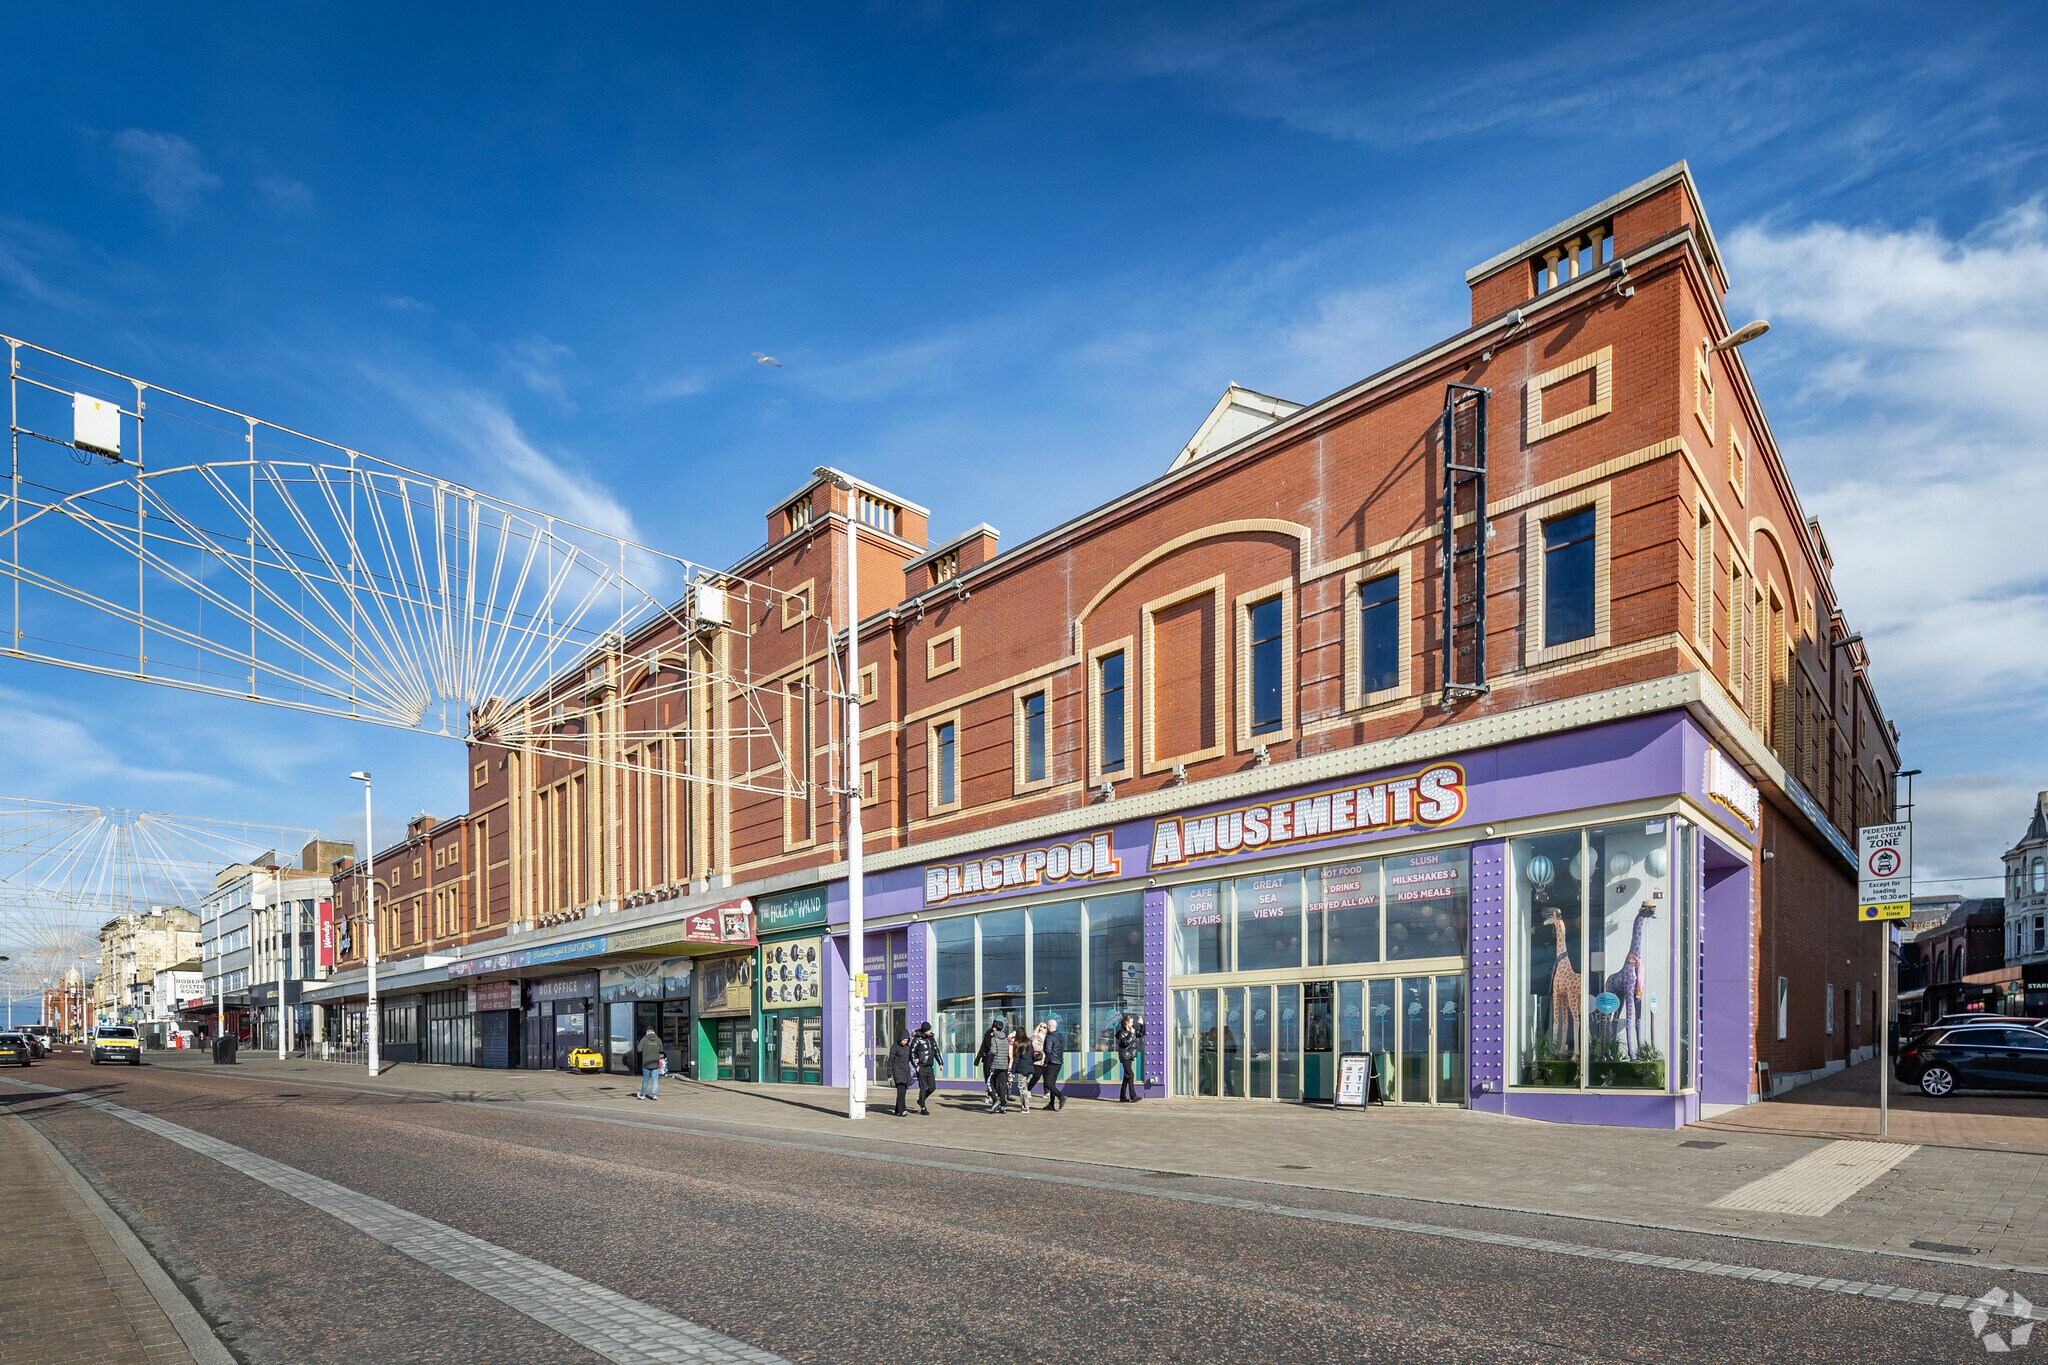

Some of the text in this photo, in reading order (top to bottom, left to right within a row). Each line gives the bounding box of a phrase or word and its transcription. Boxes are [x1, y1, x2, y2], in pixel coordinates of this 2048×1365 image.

[1152, 766, 1463, 866] AMUSEMENTS
[1862, 825, 1907, 835] PEDESTRIAN
[1880, 831, 1903, 839] CYCLE
[1869, 838, 1900, 849] ZONE
[1409, 855, 1439, 867] SLUSH
[925, 832, 1118, 904] BLACKPOOL
[1320, 866, 1362, 879] HOT FOOD
[1392, 869, 1459, 886] MILKSHAKES &
[1253, 878, 1284, 891] GREAT
[1323, 881, 1360, 894] & DRINKS
[1868, 881, 1890, 889] Except
[1190, 887, 1213, 899] CAFE
[1258, 893, 1278, 905] SEA
[1398, 887, 1452, 901] KIDS MEALS
[770, 903, 788, 922] HOLE
[797, 897, 821, 918] WAND
[1189, 902, 1213, 913] OPEN
[1308, 896, 1376, 912] SERVED ALL DAY
[1892, 904, 1904, 913] any
[1253, 906, 1284, 919] VIEWS
[321, 920, 333, 949] Wendy's
[863, 955, 885, 963] LACKPOOL
[893, 953, 907, 961] BLACK
[538, 983, 552, 996] BOX
[553, 980, 578, 994] OFFICE
